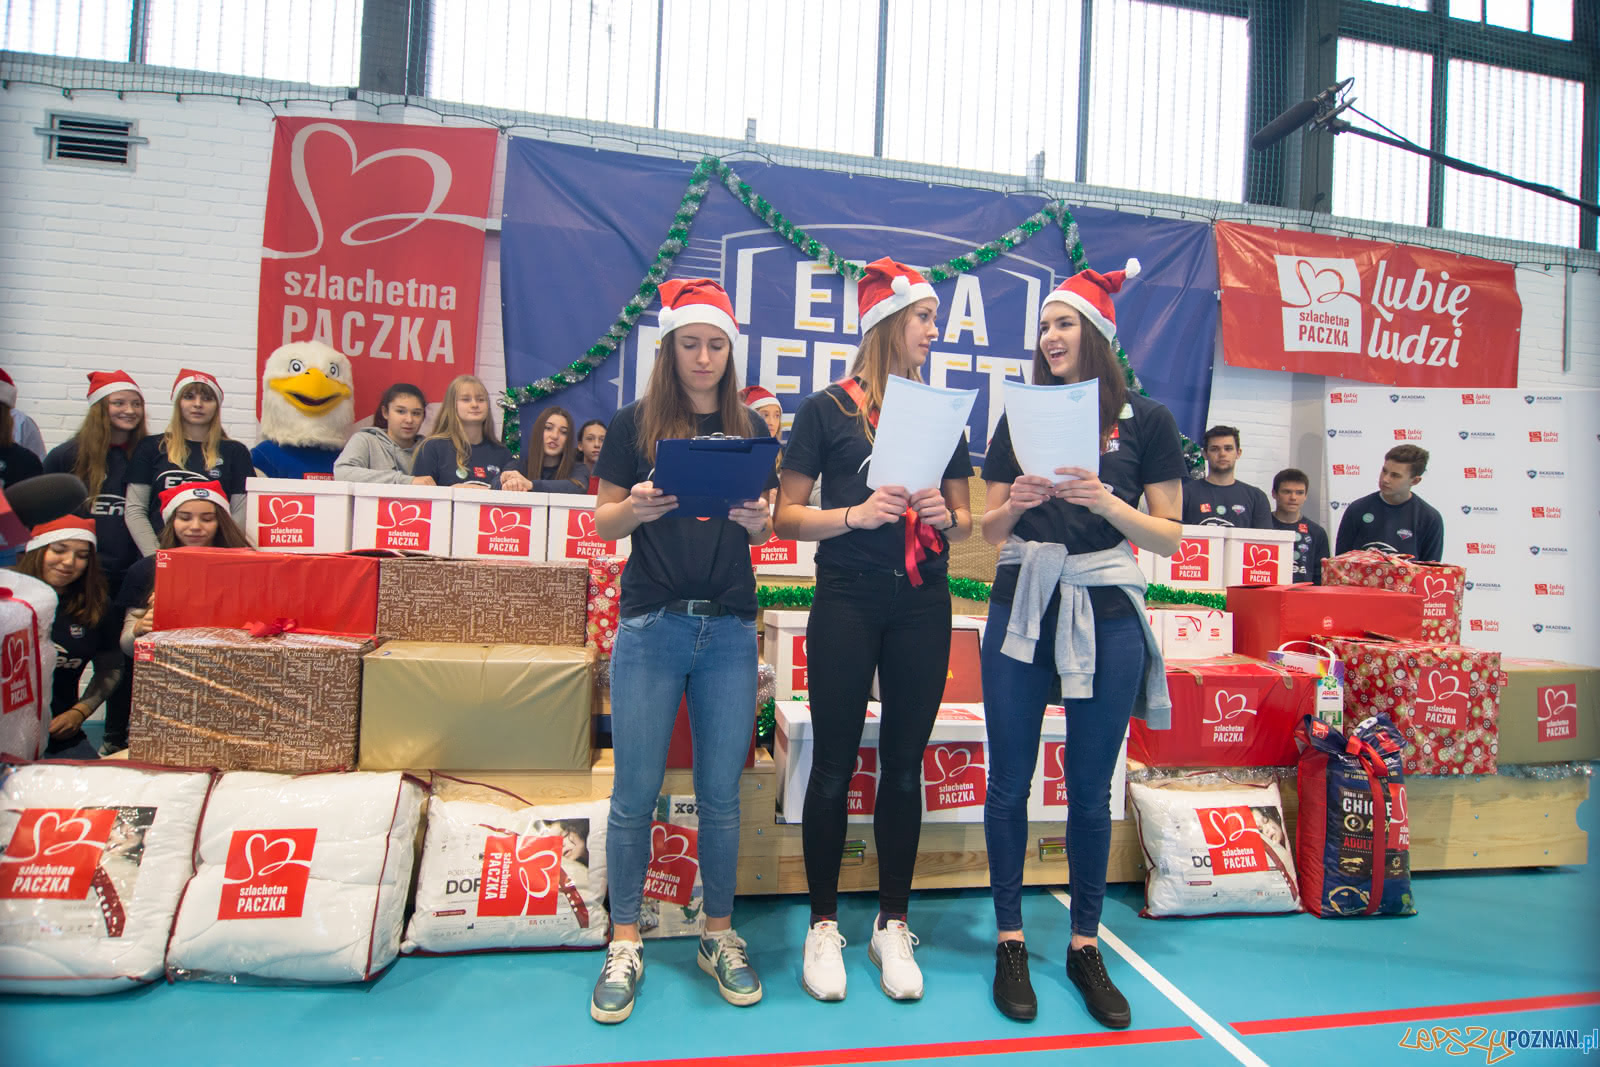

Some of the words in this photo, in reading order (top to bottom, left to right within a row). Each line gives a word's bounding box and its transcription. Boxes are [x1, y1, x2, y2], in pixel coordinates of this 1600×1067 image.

[284, 265, 456, 310] szlachetna
[1299, 310, 1350, 327] szlachetna
[282, 305, 455, 364] PACZKA
[1298, 324, 1349, 348] PACZKA
[1367, 317, 1463, 369] ludzi
[270, 534, 303, 544] PACZKA
[387, 537, 419, 547] PACZKA
[488, 543, 519, 553] PACZKA
[760, 553, 789, 561] PACZKA
[1179, 570, 1201, 578] PACZKA
[1249, 575, 1271, 583] PACZKA
[1423, 608, 1447, 617] PACZKA
[1427, 705, 1457, 715] szlachetna
[1425, 712, 1457, 725] PACZKA
[1214, 725, 1245, 733] szlachetna
[1546, 726, 1570, 738] PACZKA
[1213, 732, 1244, 743] PACZKA
[938, 782, 975, 792] szlachetna
[939, 790, 976, 805] PACZKA
[1222, 846, 1255, 857] szlachetna
[1223, 855, 1258, 870] PACZKA
[18, 864, 75, 876] szlachetna
[484, 852, 503, 900] PACZKA
[499, 852, 513, 899] szlachetna
[11, 876, 70, 893] PACZKA
[239, 884, 288, 897] szlachetna
[643, 879, 678, 897] ACZKA
[236, 896, 286, 913] PACZKA
